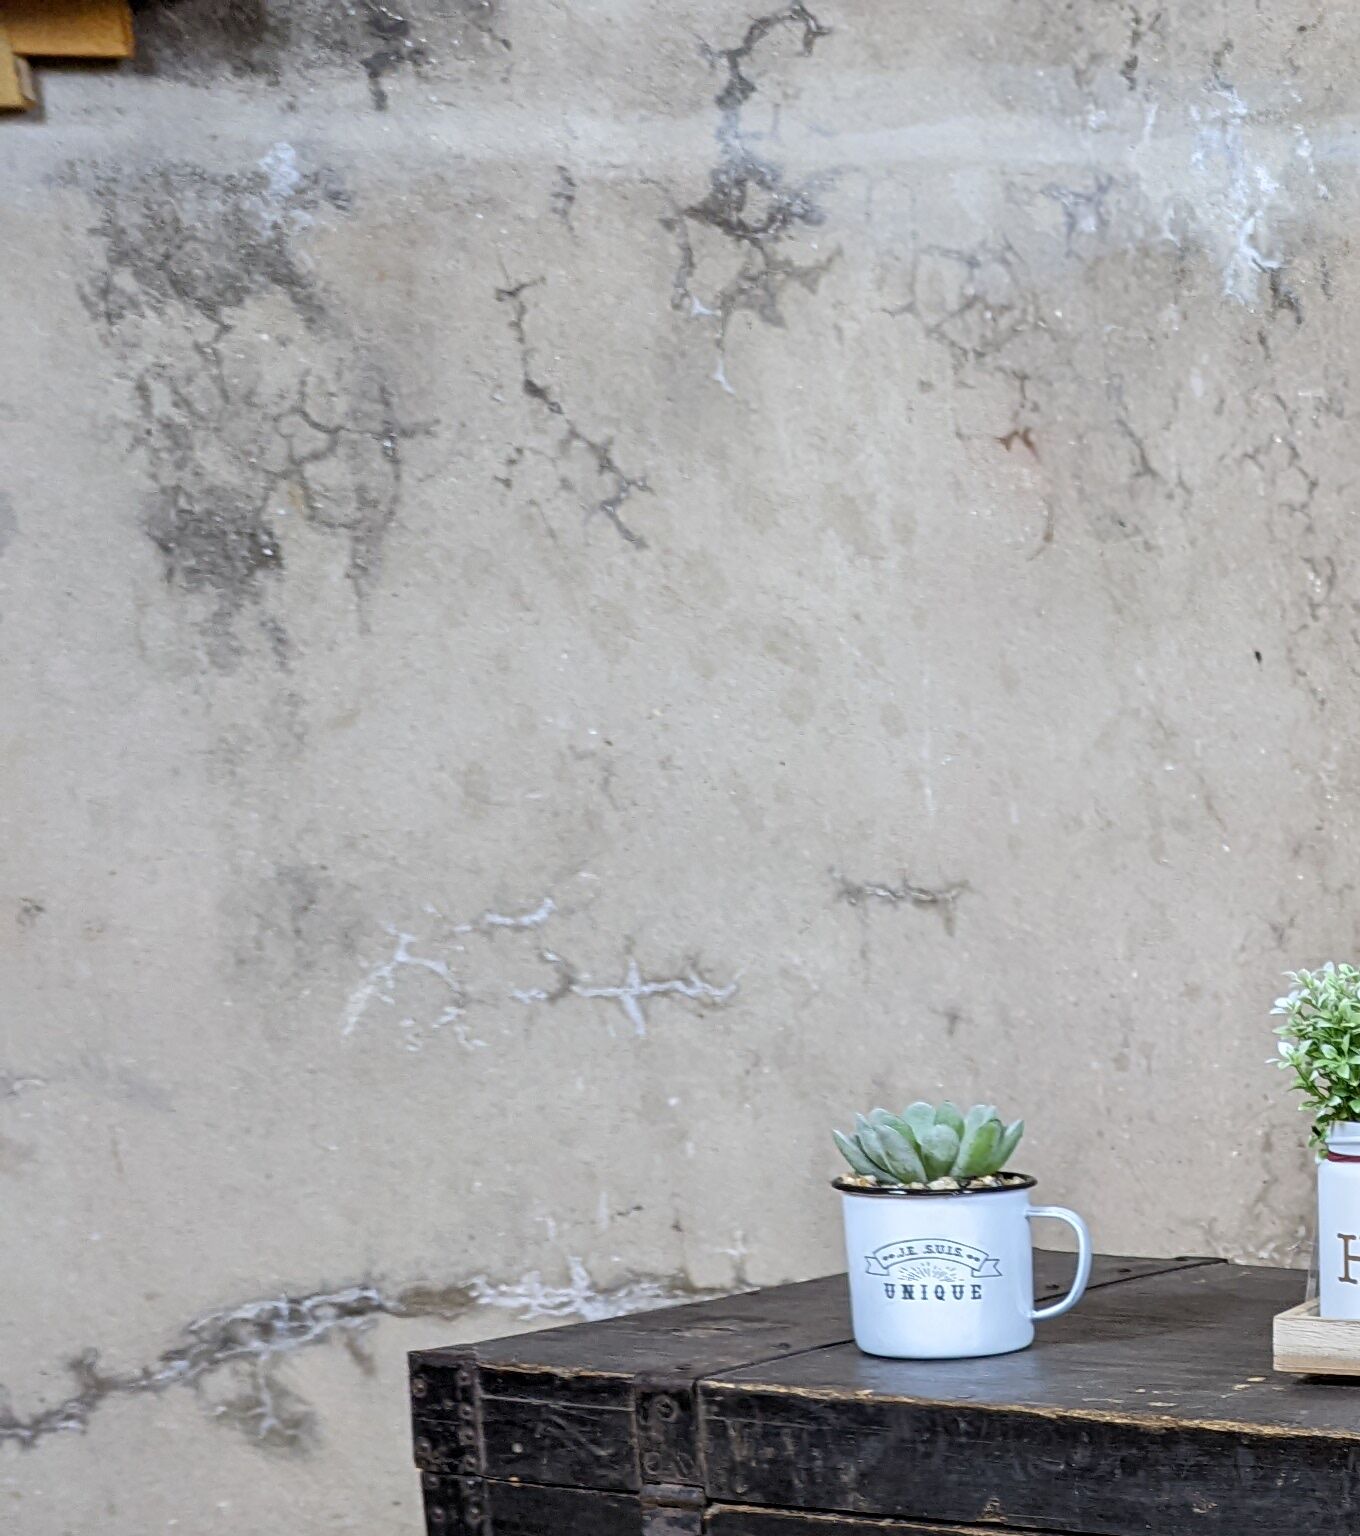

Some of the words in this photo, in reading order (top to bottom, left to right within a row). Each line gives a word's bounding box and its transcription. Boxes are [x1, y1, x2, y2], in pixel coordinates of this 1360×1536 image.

[897, 1245, 918, 1258] JE
[923, 1244, 964, 1258] SUIS
[883, 1282, 982, 1301] UNIQUE
